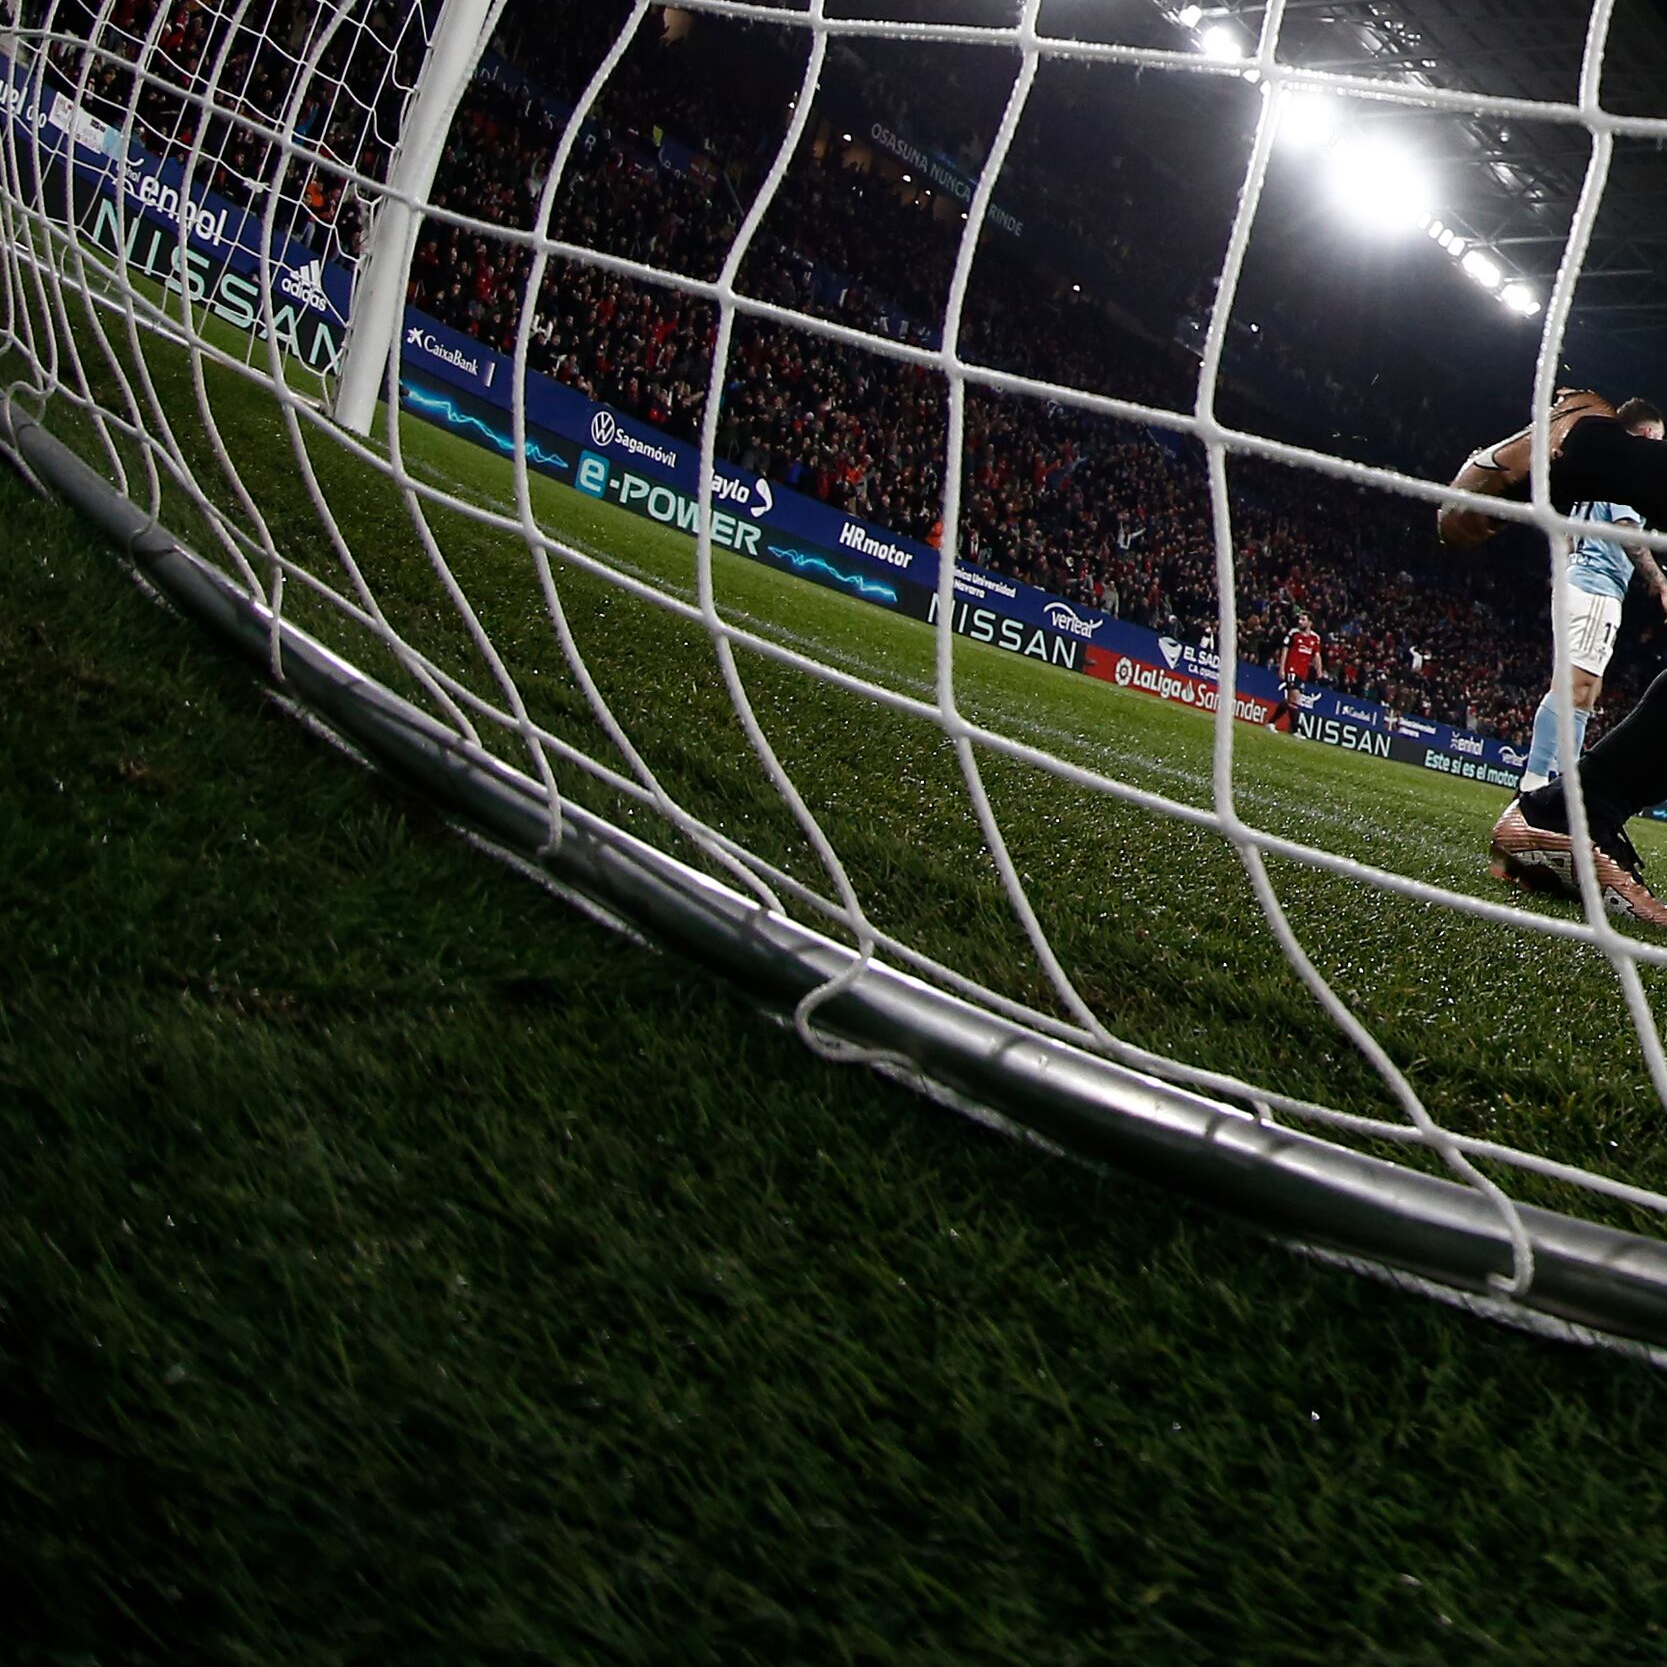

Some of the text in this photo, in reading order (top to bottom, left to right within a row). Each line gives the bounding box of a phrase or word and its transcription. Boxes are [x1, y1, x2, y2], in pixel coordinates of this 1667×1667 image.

[280, 276, 328, 312] adidas
[424, 333, 479, 377] CaixaBank
[614, 427, 677, 469] Sagamóvil
[711, 468, 750, 504] aylo
[838, 521, 913, 569] HRmotor
[927, 592, 1078, 670] NISSAN
[1198, 651, 1221, 670] SAD
[1132, 664, 1182, 700] LaLiga
[1195, 683, 1269, 724] Sannder
[1298, 711, 1392, 758] NISSAN
[1424, 748, 1450, 772] Este
[1462, 762, 1476, 778] es
[1476, 762, 1488, 781] el
[1487, 767, 1520, 788] motor
